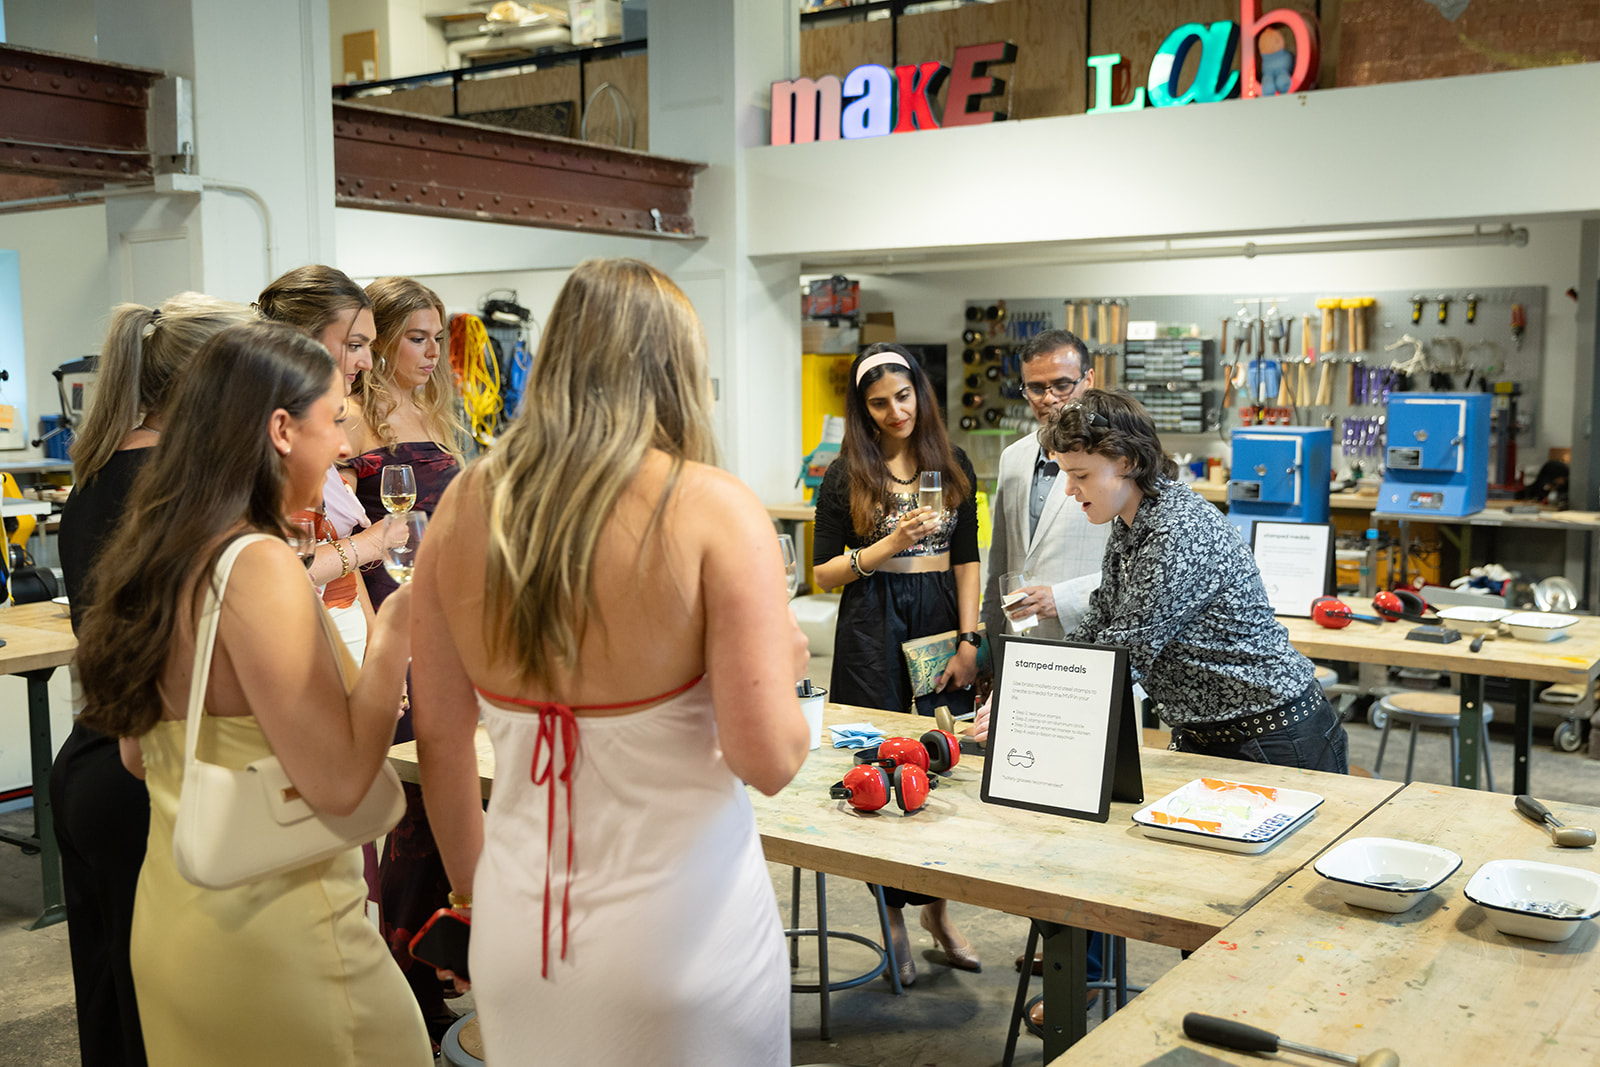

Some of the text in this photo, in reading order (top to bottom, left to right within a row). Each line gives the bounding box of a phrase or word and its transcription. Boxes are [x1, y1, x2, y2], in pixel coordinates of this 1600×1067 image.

[1087, 0, 1320, 115] Lab
[1015, 659, 1087, 674] stamped medals
